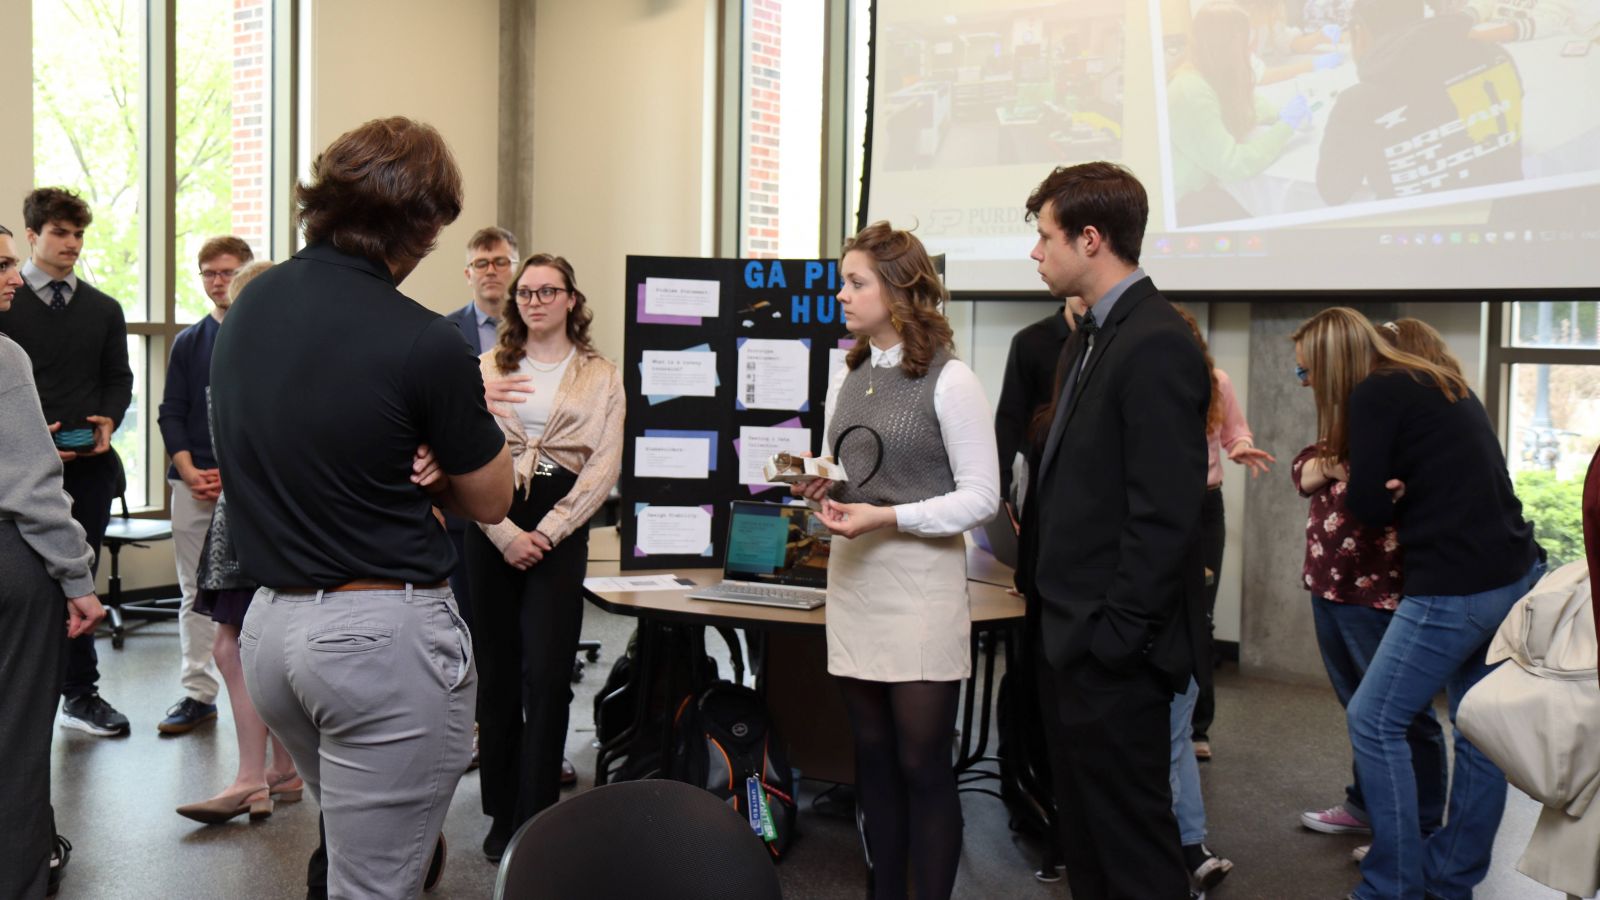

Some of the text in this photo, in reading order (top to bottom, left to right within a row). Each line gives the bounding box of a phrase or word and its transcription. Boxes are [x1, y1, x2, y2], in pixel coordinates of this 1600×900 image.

[744, 260, 846, 289] GA PI
[751, 789, 760, 819] UNITED
[760, 795, 774, 837] ONTIER
